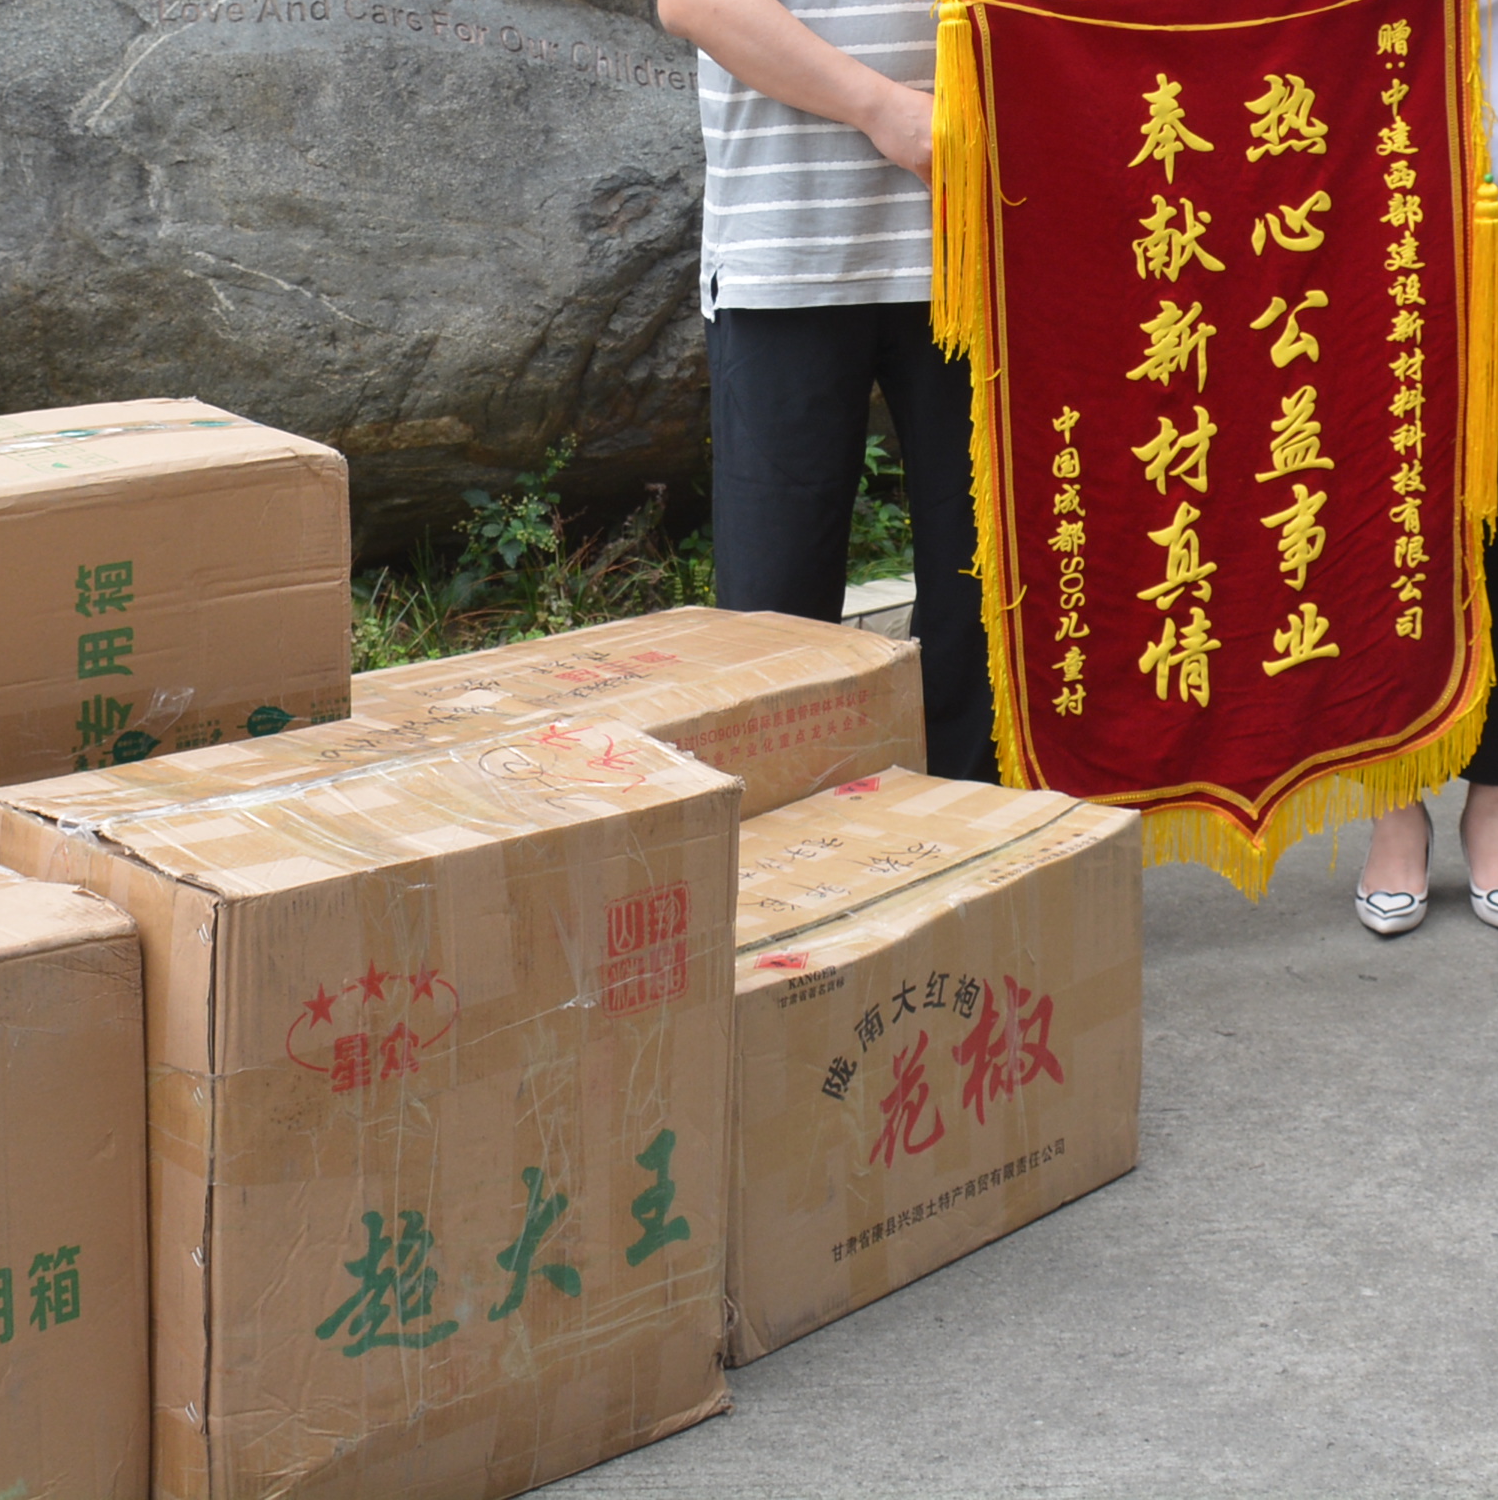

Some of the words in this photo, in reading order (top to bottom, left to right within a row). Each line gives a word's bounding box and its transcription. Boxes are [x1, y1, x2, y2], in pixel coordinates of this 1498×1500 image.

[432, 9, 489, 45] For
[501, 25, 558, 62] Our
[1126, 72, 1226, 708] 奉献新材真情
[1244, 73, 1340, 677] 热心公益事业
[1048, 405, 1090, 717] 中国成都SOS儿童村
[331, 1022, 420, 1092] 星众
[821, 970, 981, 1101] 陇南大红袍
[869, 975, 1065, 1169] 花椒
